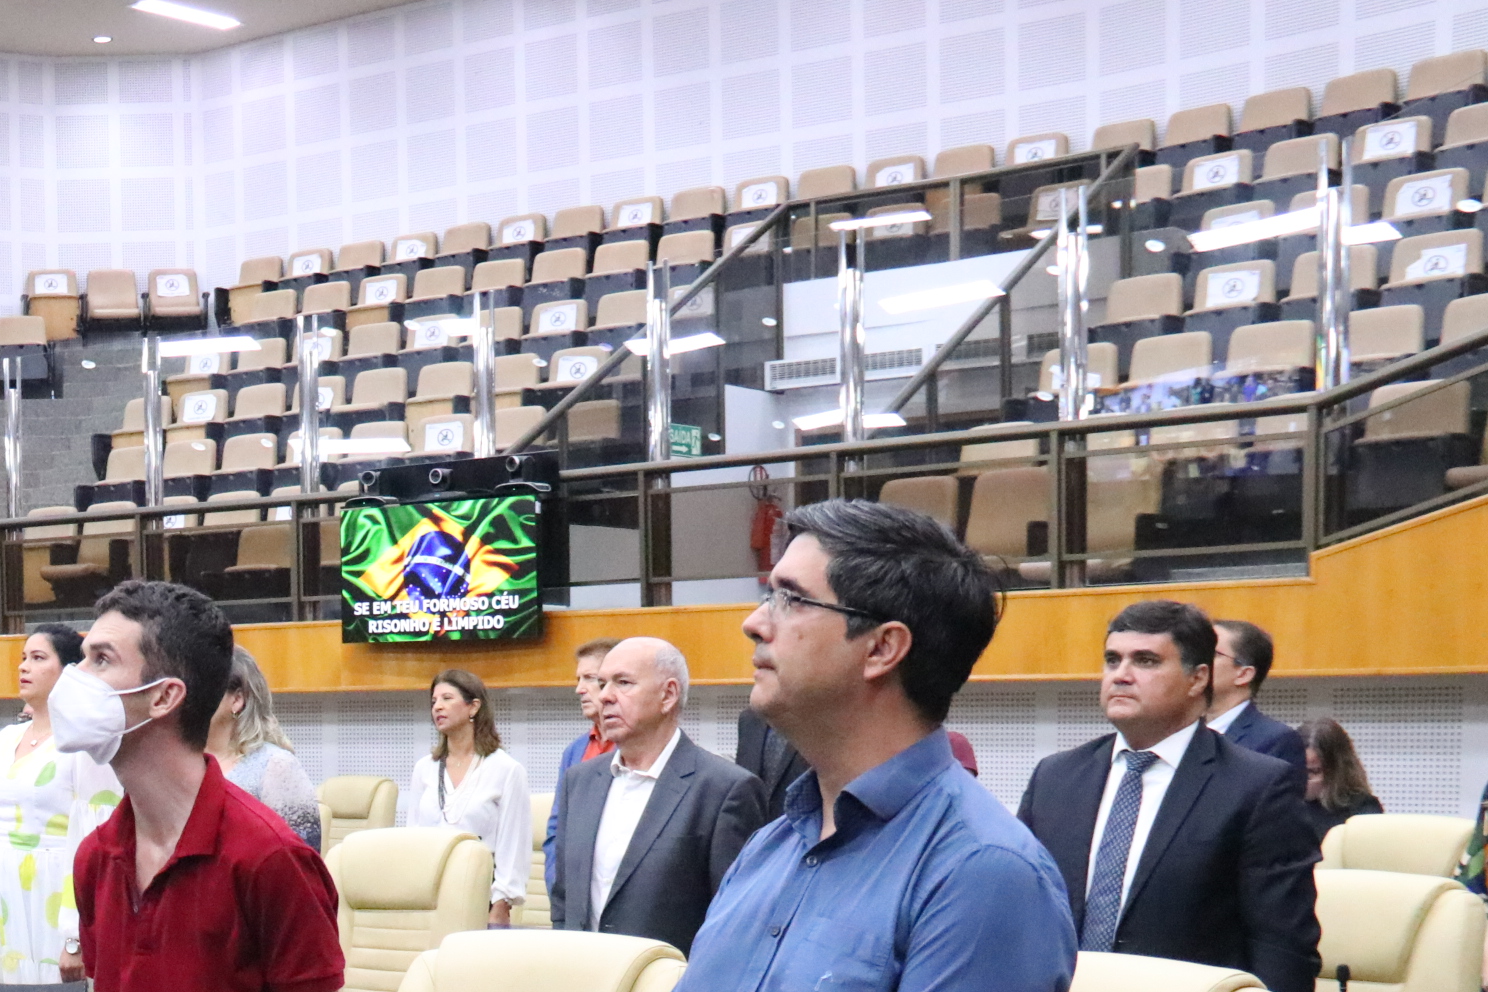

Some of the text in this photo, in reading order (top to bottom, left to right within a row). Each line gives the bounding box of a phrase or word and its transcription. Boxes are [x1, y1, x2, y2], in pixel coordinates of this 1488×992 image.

[354, 592, 519, 616] SE EM TEU FORMOSO CÉU
[368, 613, 504, 633] RISONHO E LÍMPIDO
